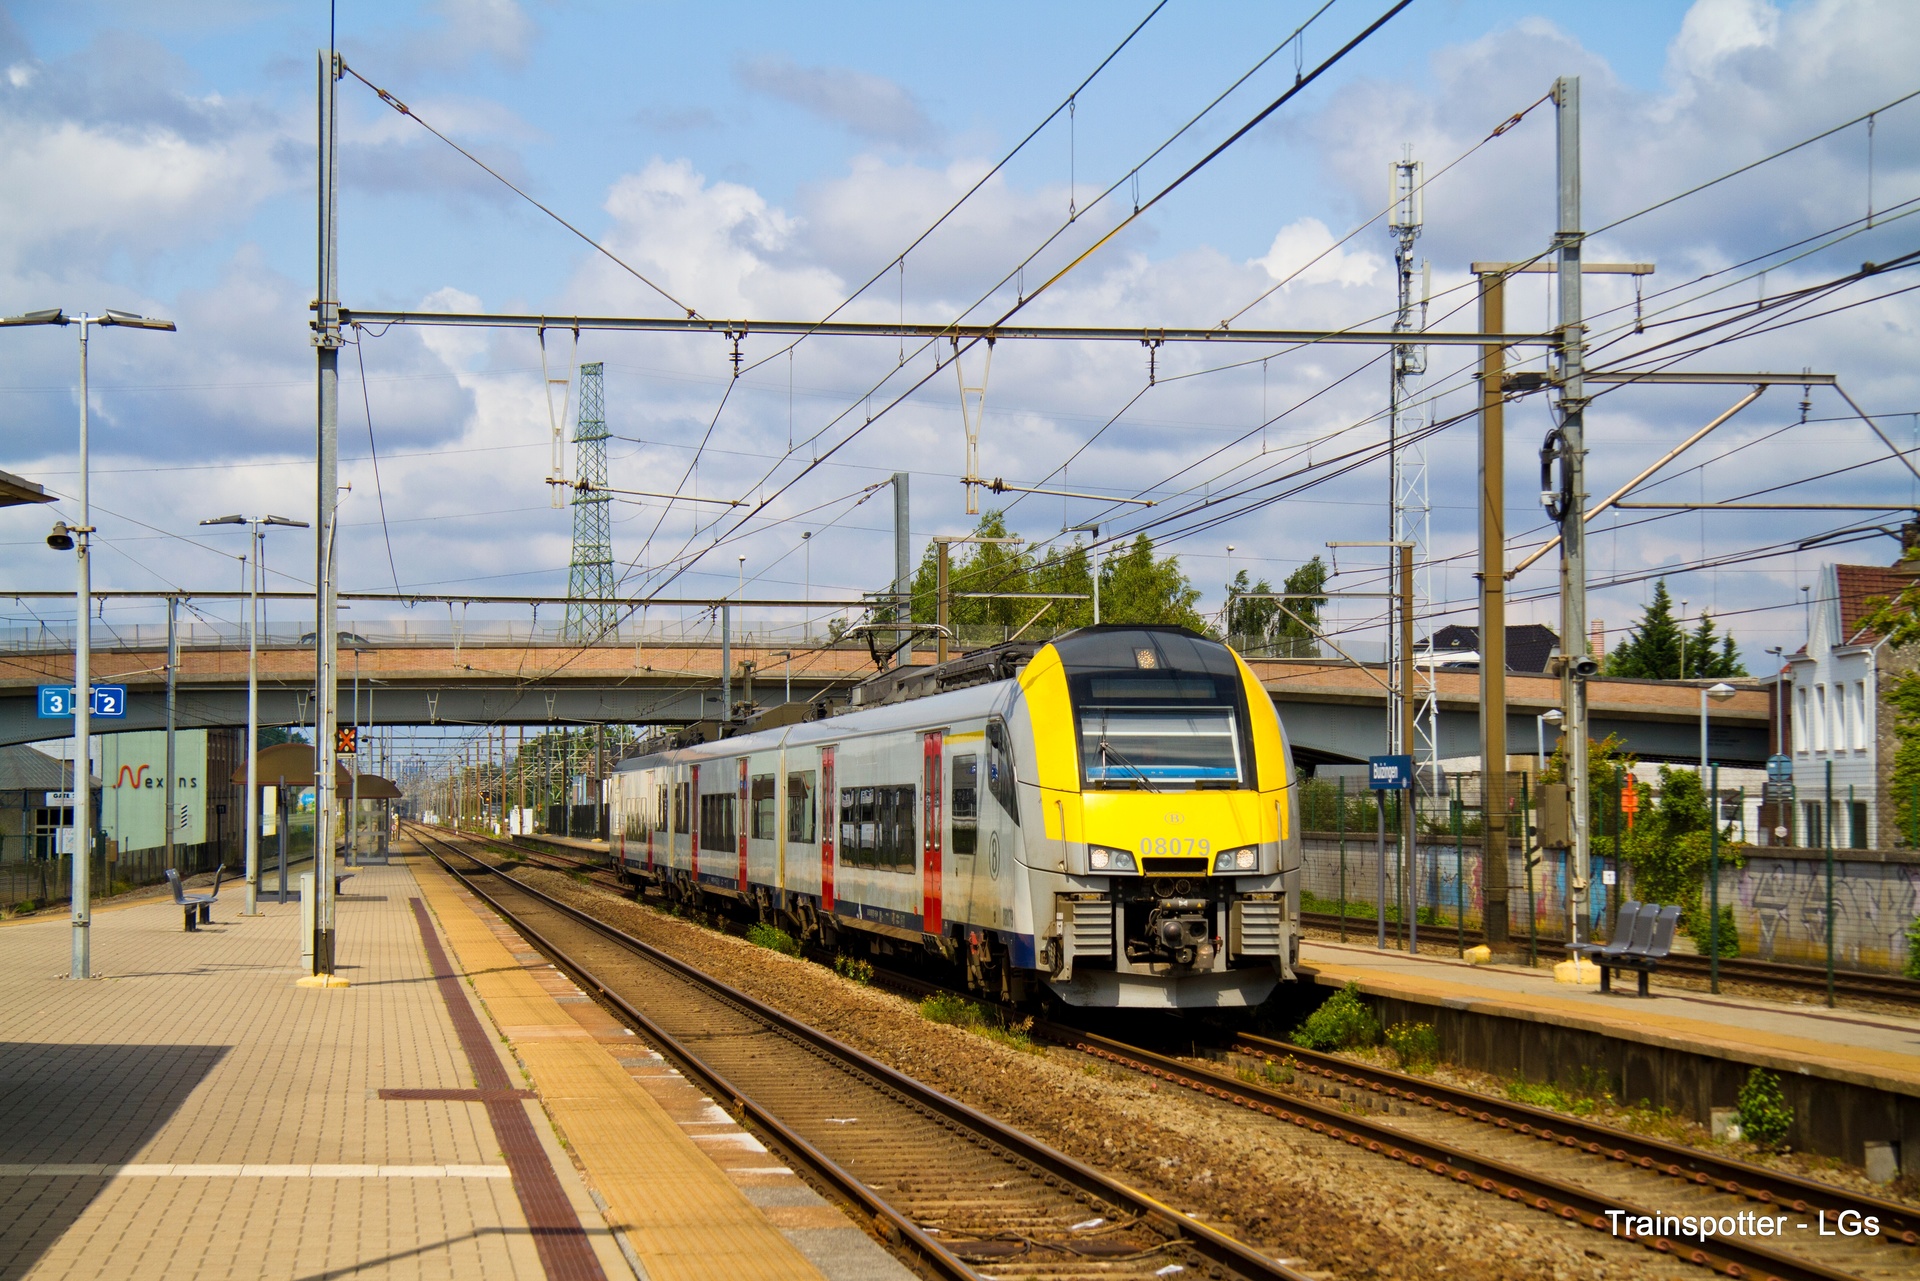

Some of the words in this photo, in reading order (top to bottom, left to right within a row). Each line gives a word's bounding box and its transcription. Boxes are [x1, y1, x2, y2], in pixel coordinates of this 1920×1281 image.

[50, 695, 63, 712] 3
[103, 696, 115, 712] 2
[113, 764, 197, 789] Nexns
[1373, 762, 1398, 783] Buizingen
[1140, 837, 1211, 857] 08079
